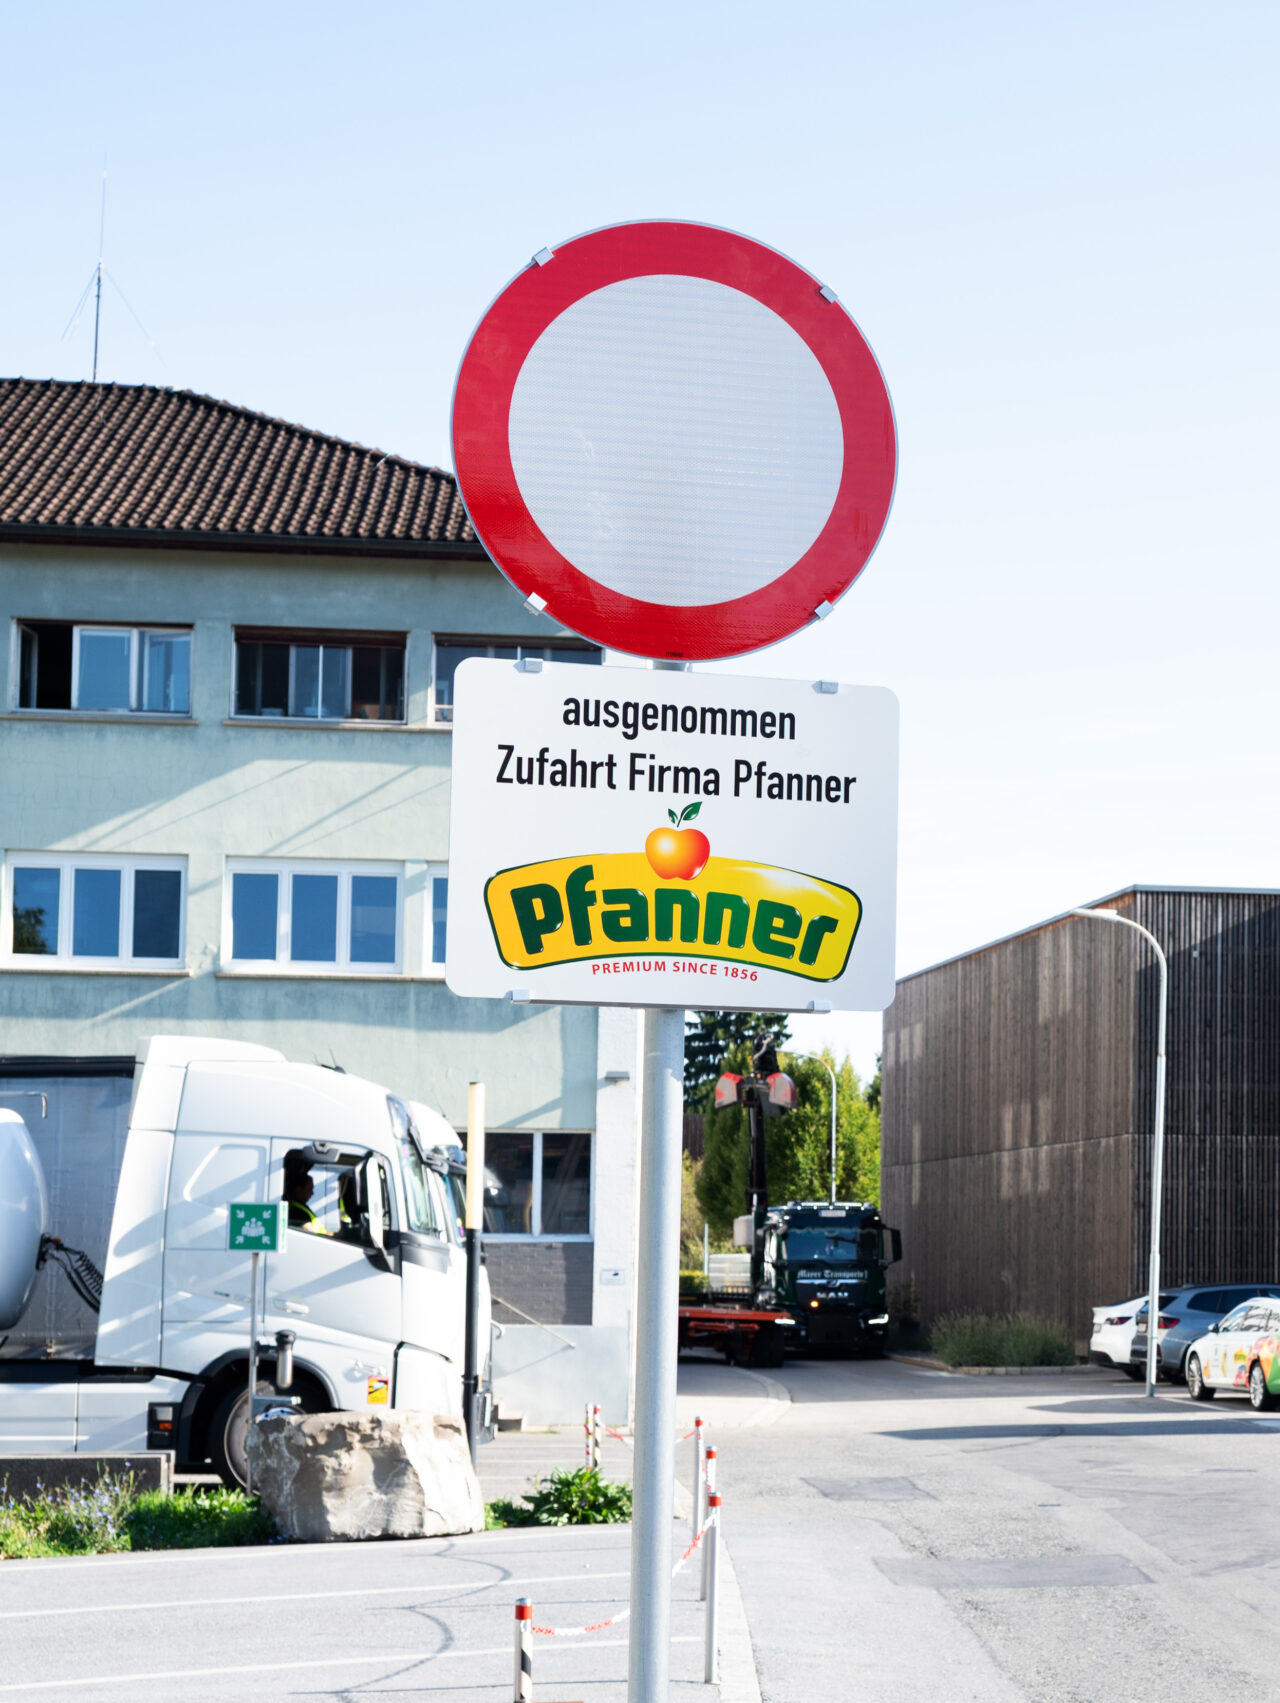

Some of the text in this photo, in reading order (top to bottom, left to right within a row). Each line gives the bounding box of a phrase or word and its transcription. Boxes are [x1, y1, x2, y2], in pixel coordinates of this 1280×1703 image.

[563, 696, 797, 741] ausgenommen
[496, 744, 857, 804] Zufahrt Firma Pfanner
[510, 864, 840, 966] pfanner
[591, 960, 759, 982] PREMIUM SINCE 1856
